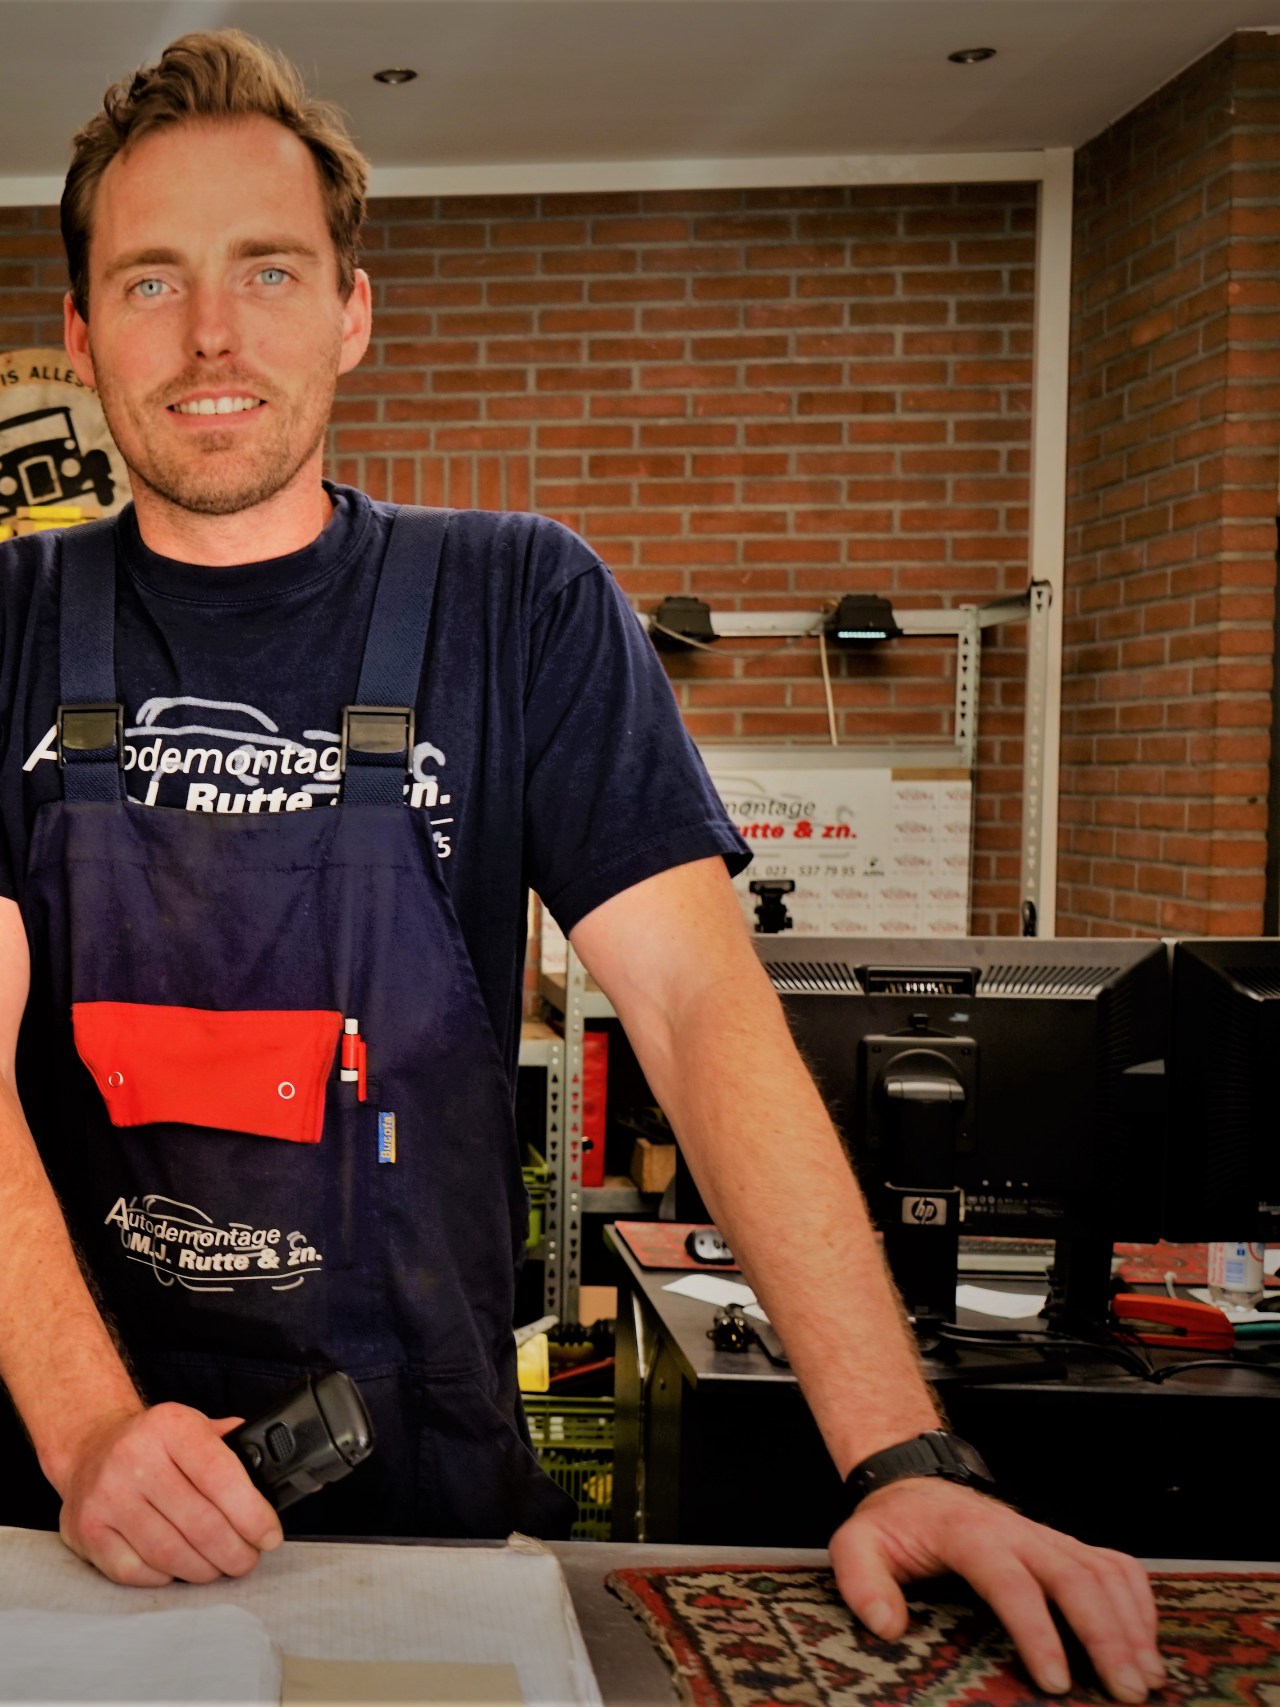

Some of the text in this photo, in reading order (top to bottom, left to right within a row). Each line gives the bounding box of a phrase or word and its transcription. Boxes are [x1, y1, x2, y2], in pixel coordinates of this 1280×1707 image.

[0, 368, 20, 387] IS
[30, 366, 85, 388] ALLES
[22, 724, 341, 781] Aodemontag
[186, 782, 314, 814] Rutte
[403, 780, 451, 808] n.
[737, 819, 858, 839] utte & zn.
[380, 1115, 392, 1159] Bucofa
[103, 1196, 282, 1248] Autodemontage
[128, 1232, 324, 1272] M.J. Rutte & zn.
